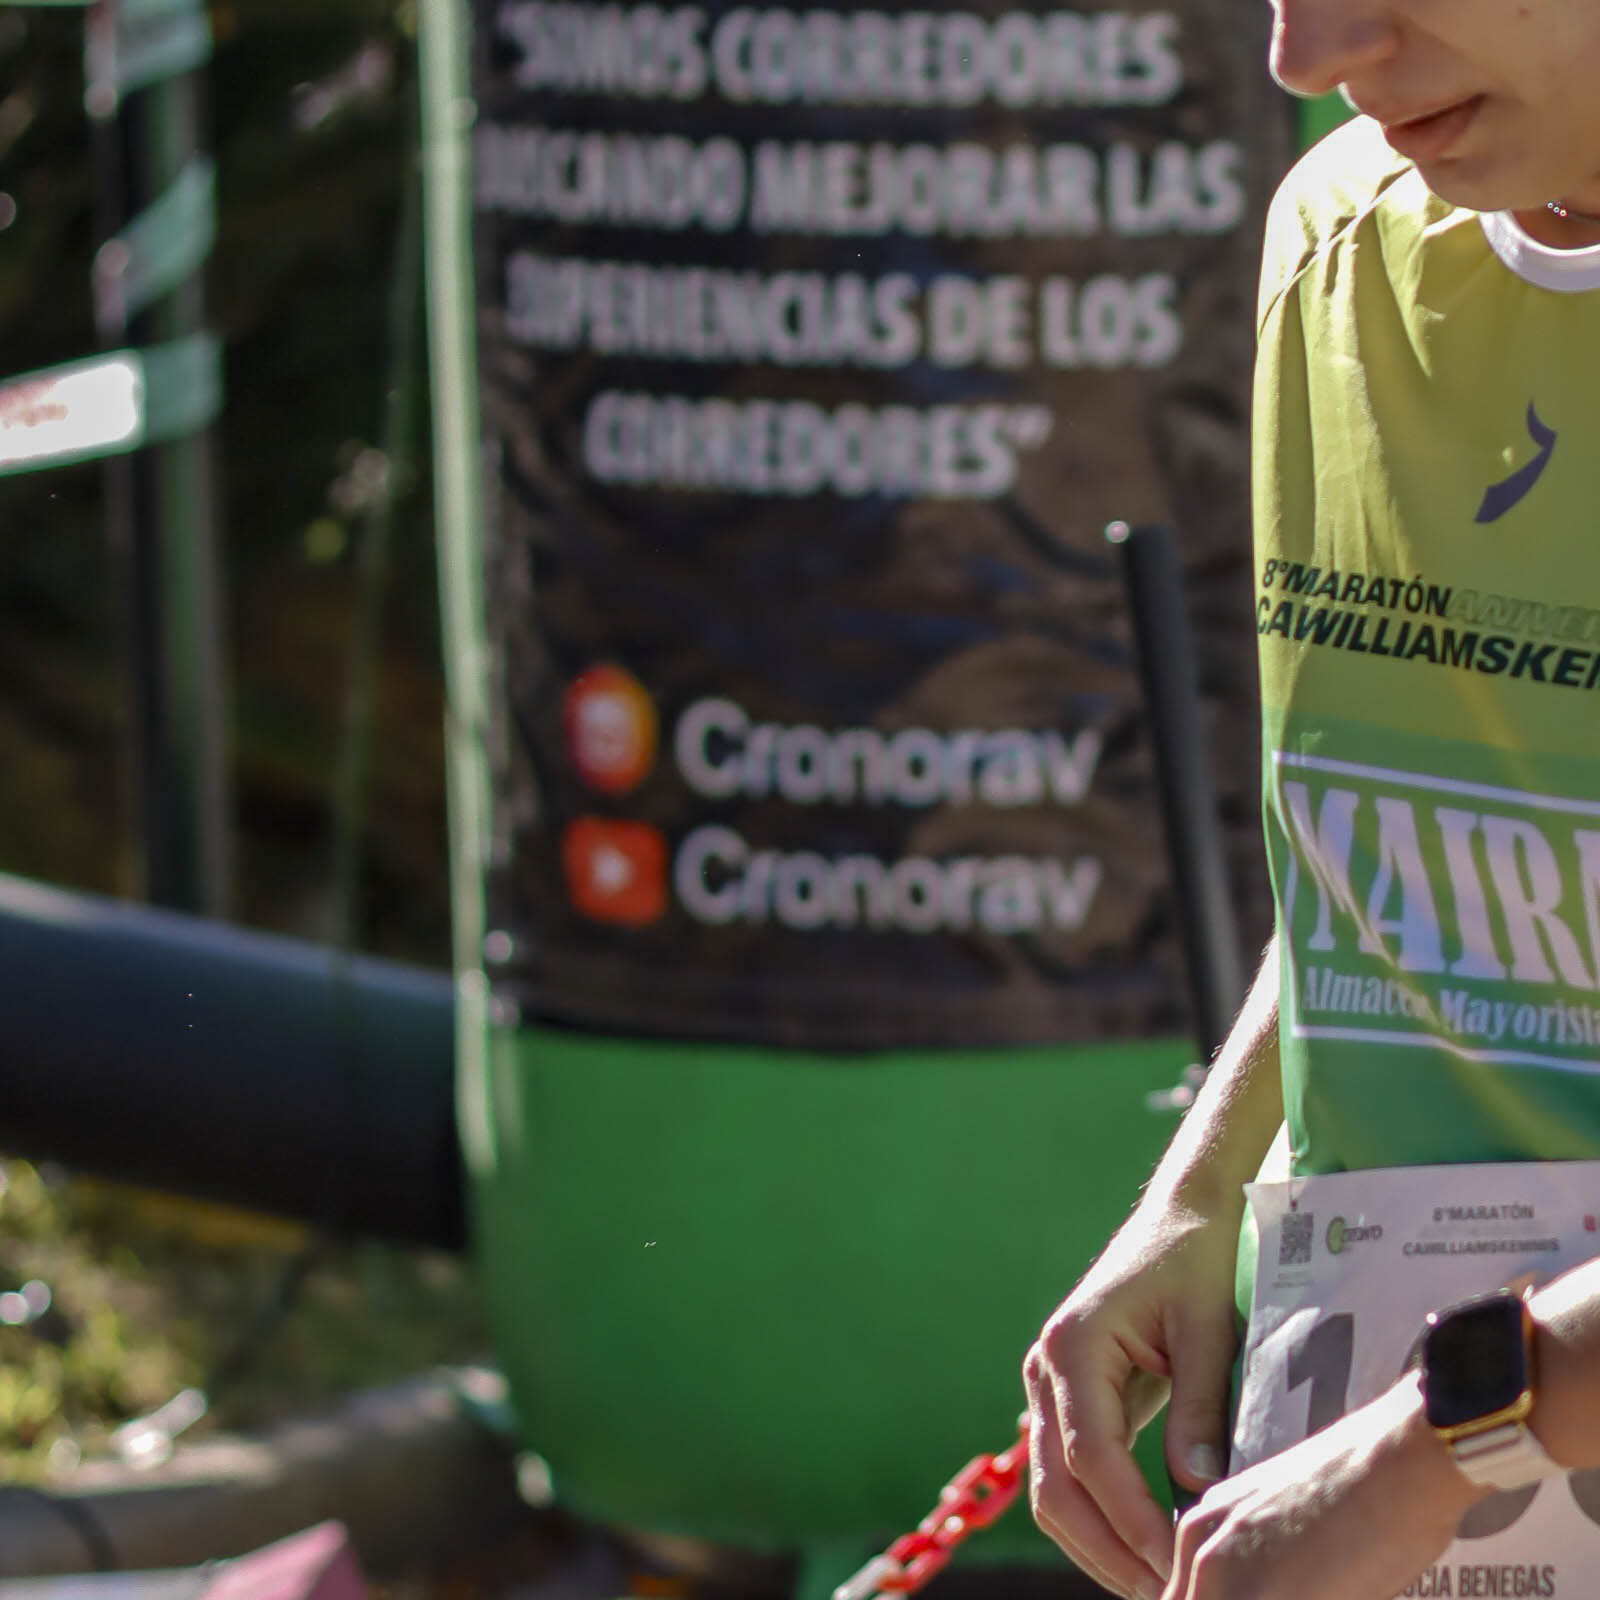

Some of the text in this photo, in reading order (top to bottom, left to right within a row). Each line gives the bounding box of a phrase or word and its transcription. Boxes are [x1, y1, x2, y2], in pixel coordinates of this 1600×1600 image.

[714, 8, 1181, 106] CORREDORES
[750, 142, 1099, 236] MEJORAR
[1108, 142, 1245, 232] LAS
[926, 272, 1032, 363] DE
[1041, 274, 1182, 369] LOS
[675, 697, 1102, 805] Cronorav
[675, 824, 1102, 932] Cronorav
[1458, 1563, 1556, 1599] BENEGAS
